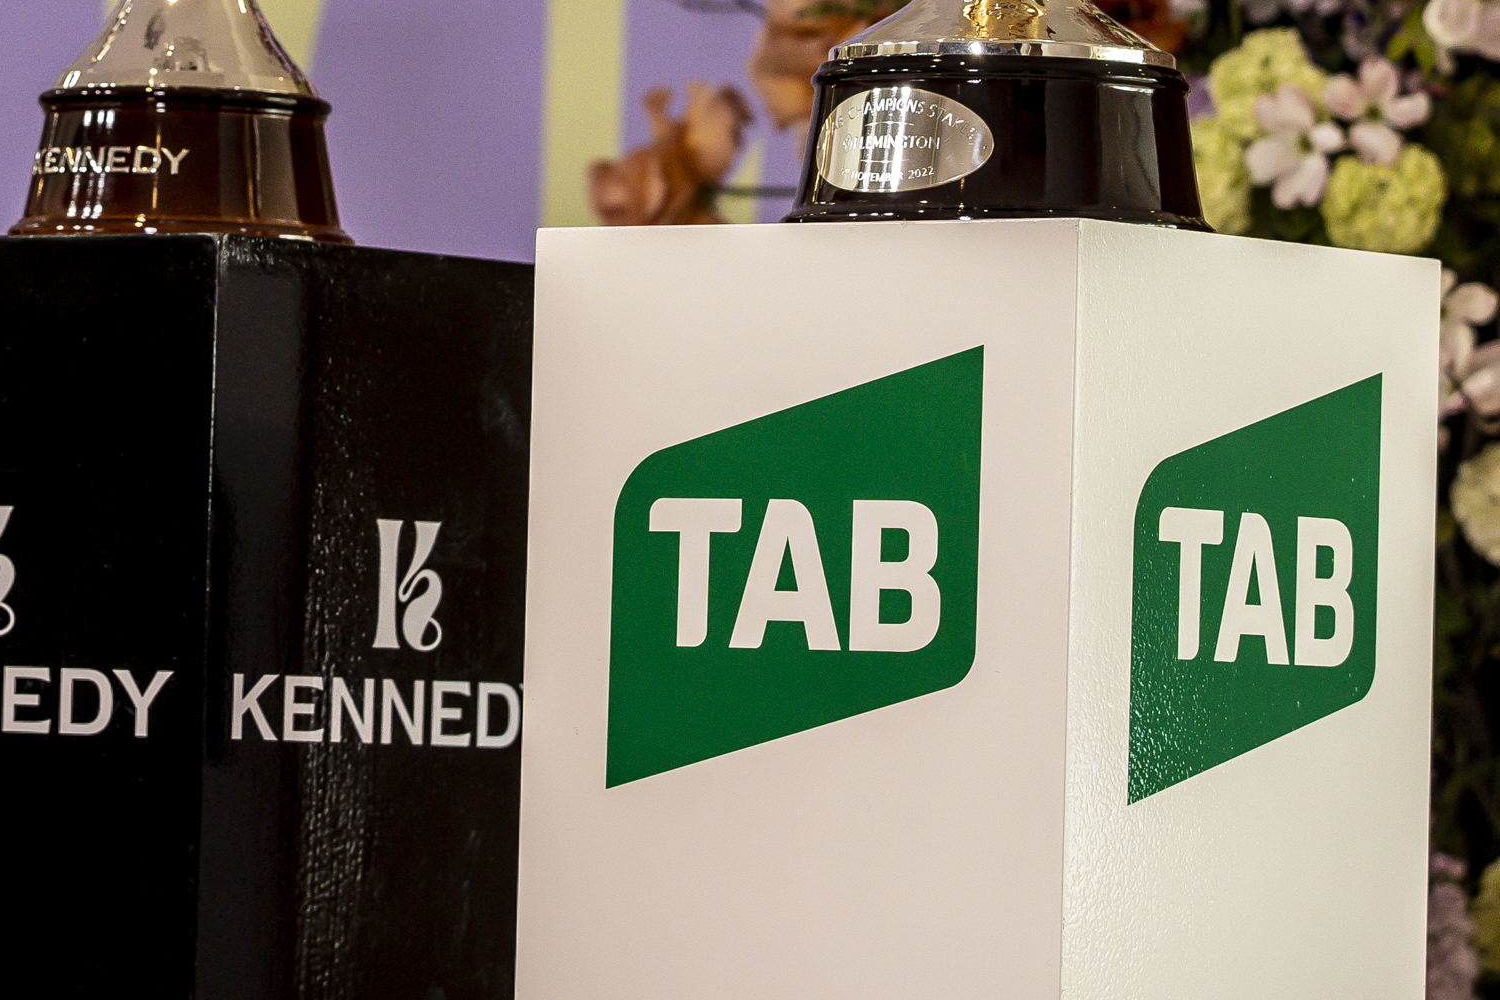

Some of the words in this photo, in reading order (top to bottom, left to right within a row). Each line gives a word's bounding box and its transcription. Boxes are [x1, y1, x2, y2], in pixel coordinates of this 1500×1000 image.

[848, 98, 926, 120] CHAMPIONS
[849, 134, 941, 150] FLEMINGTON
[908, 166, 935, 180] 2022
[649, 498, 941, 652] TAB
[1159, 507, 1355, 667] TAB
[231, 673, 525, 749] KENNED
